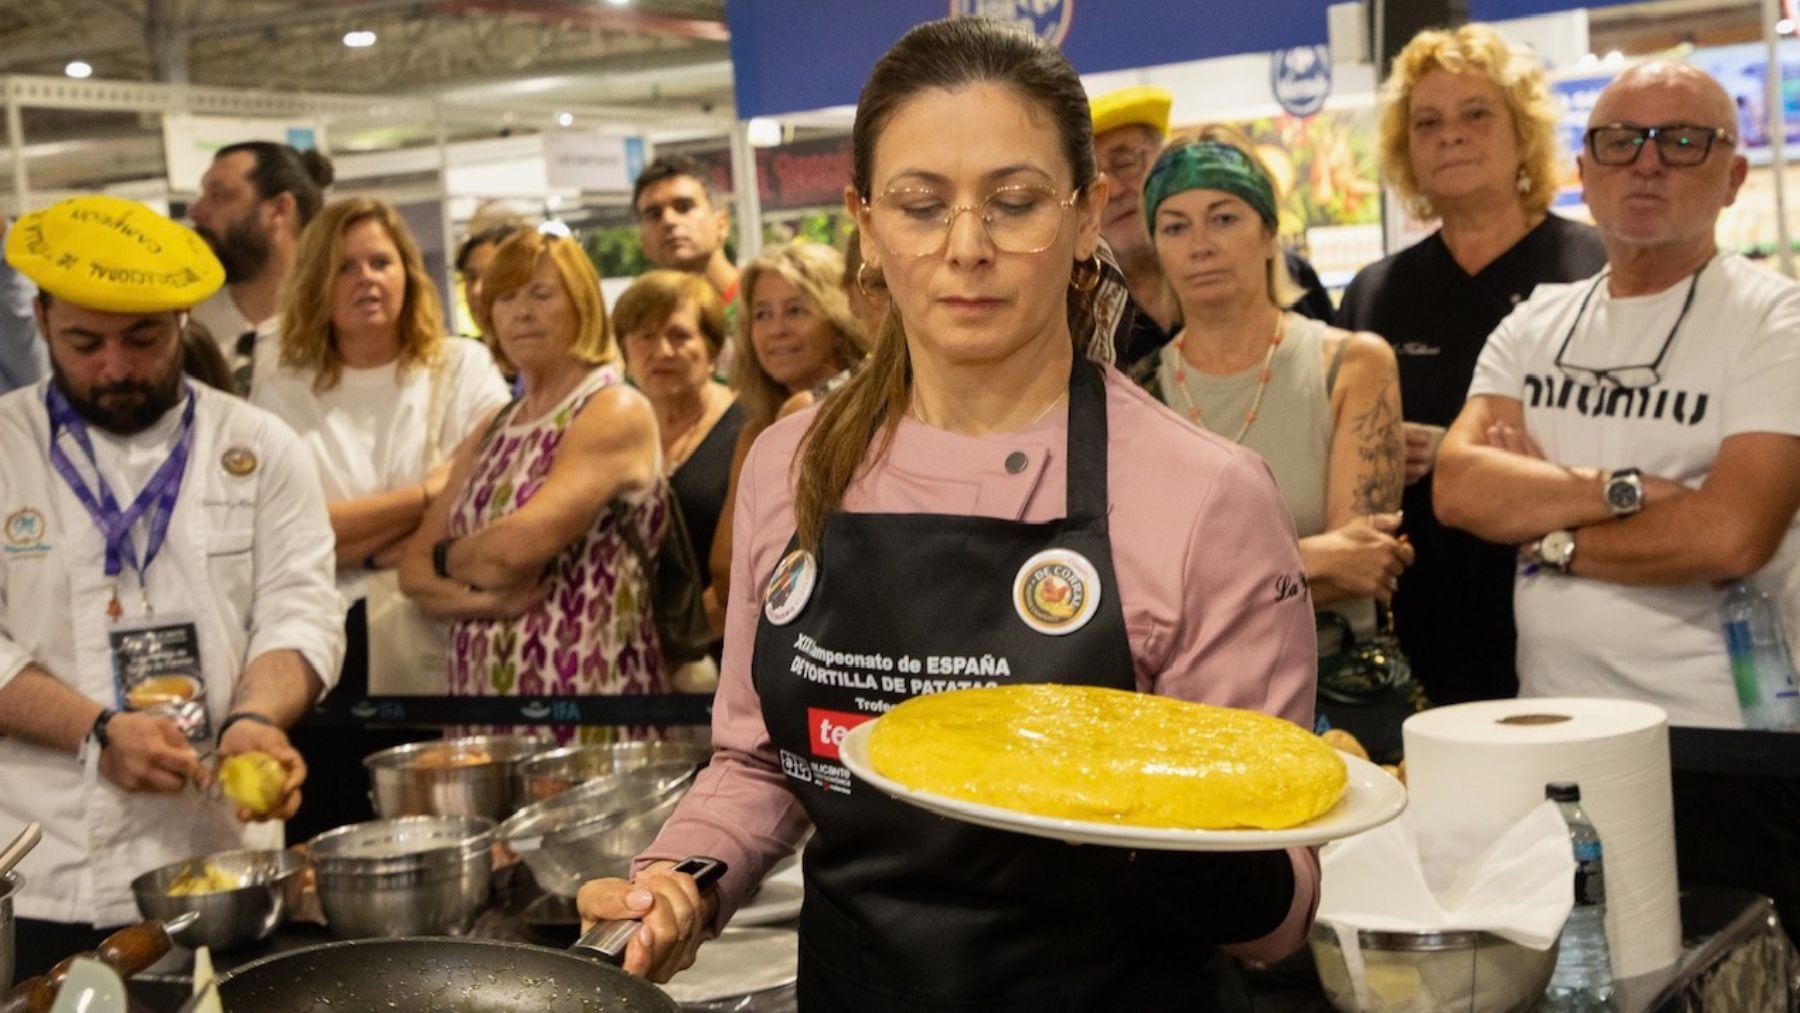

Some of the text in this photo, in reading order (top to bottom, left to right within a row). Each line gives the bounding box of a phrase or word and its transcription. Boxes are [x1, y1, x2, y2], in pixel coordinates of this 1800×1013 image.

[808, 640, 893, 672] ampeonato
[898, 655, 921, 674] de
[926, 653, 1011, 677] ESPAÑA
[803, 661, 878, 690] TORTILLA
[881, 677, 907, 694] DE
[553, 701, 580, 720] IFA
[855, 696, 896, 713] Trofe
[820, 719, 848, 746] te
